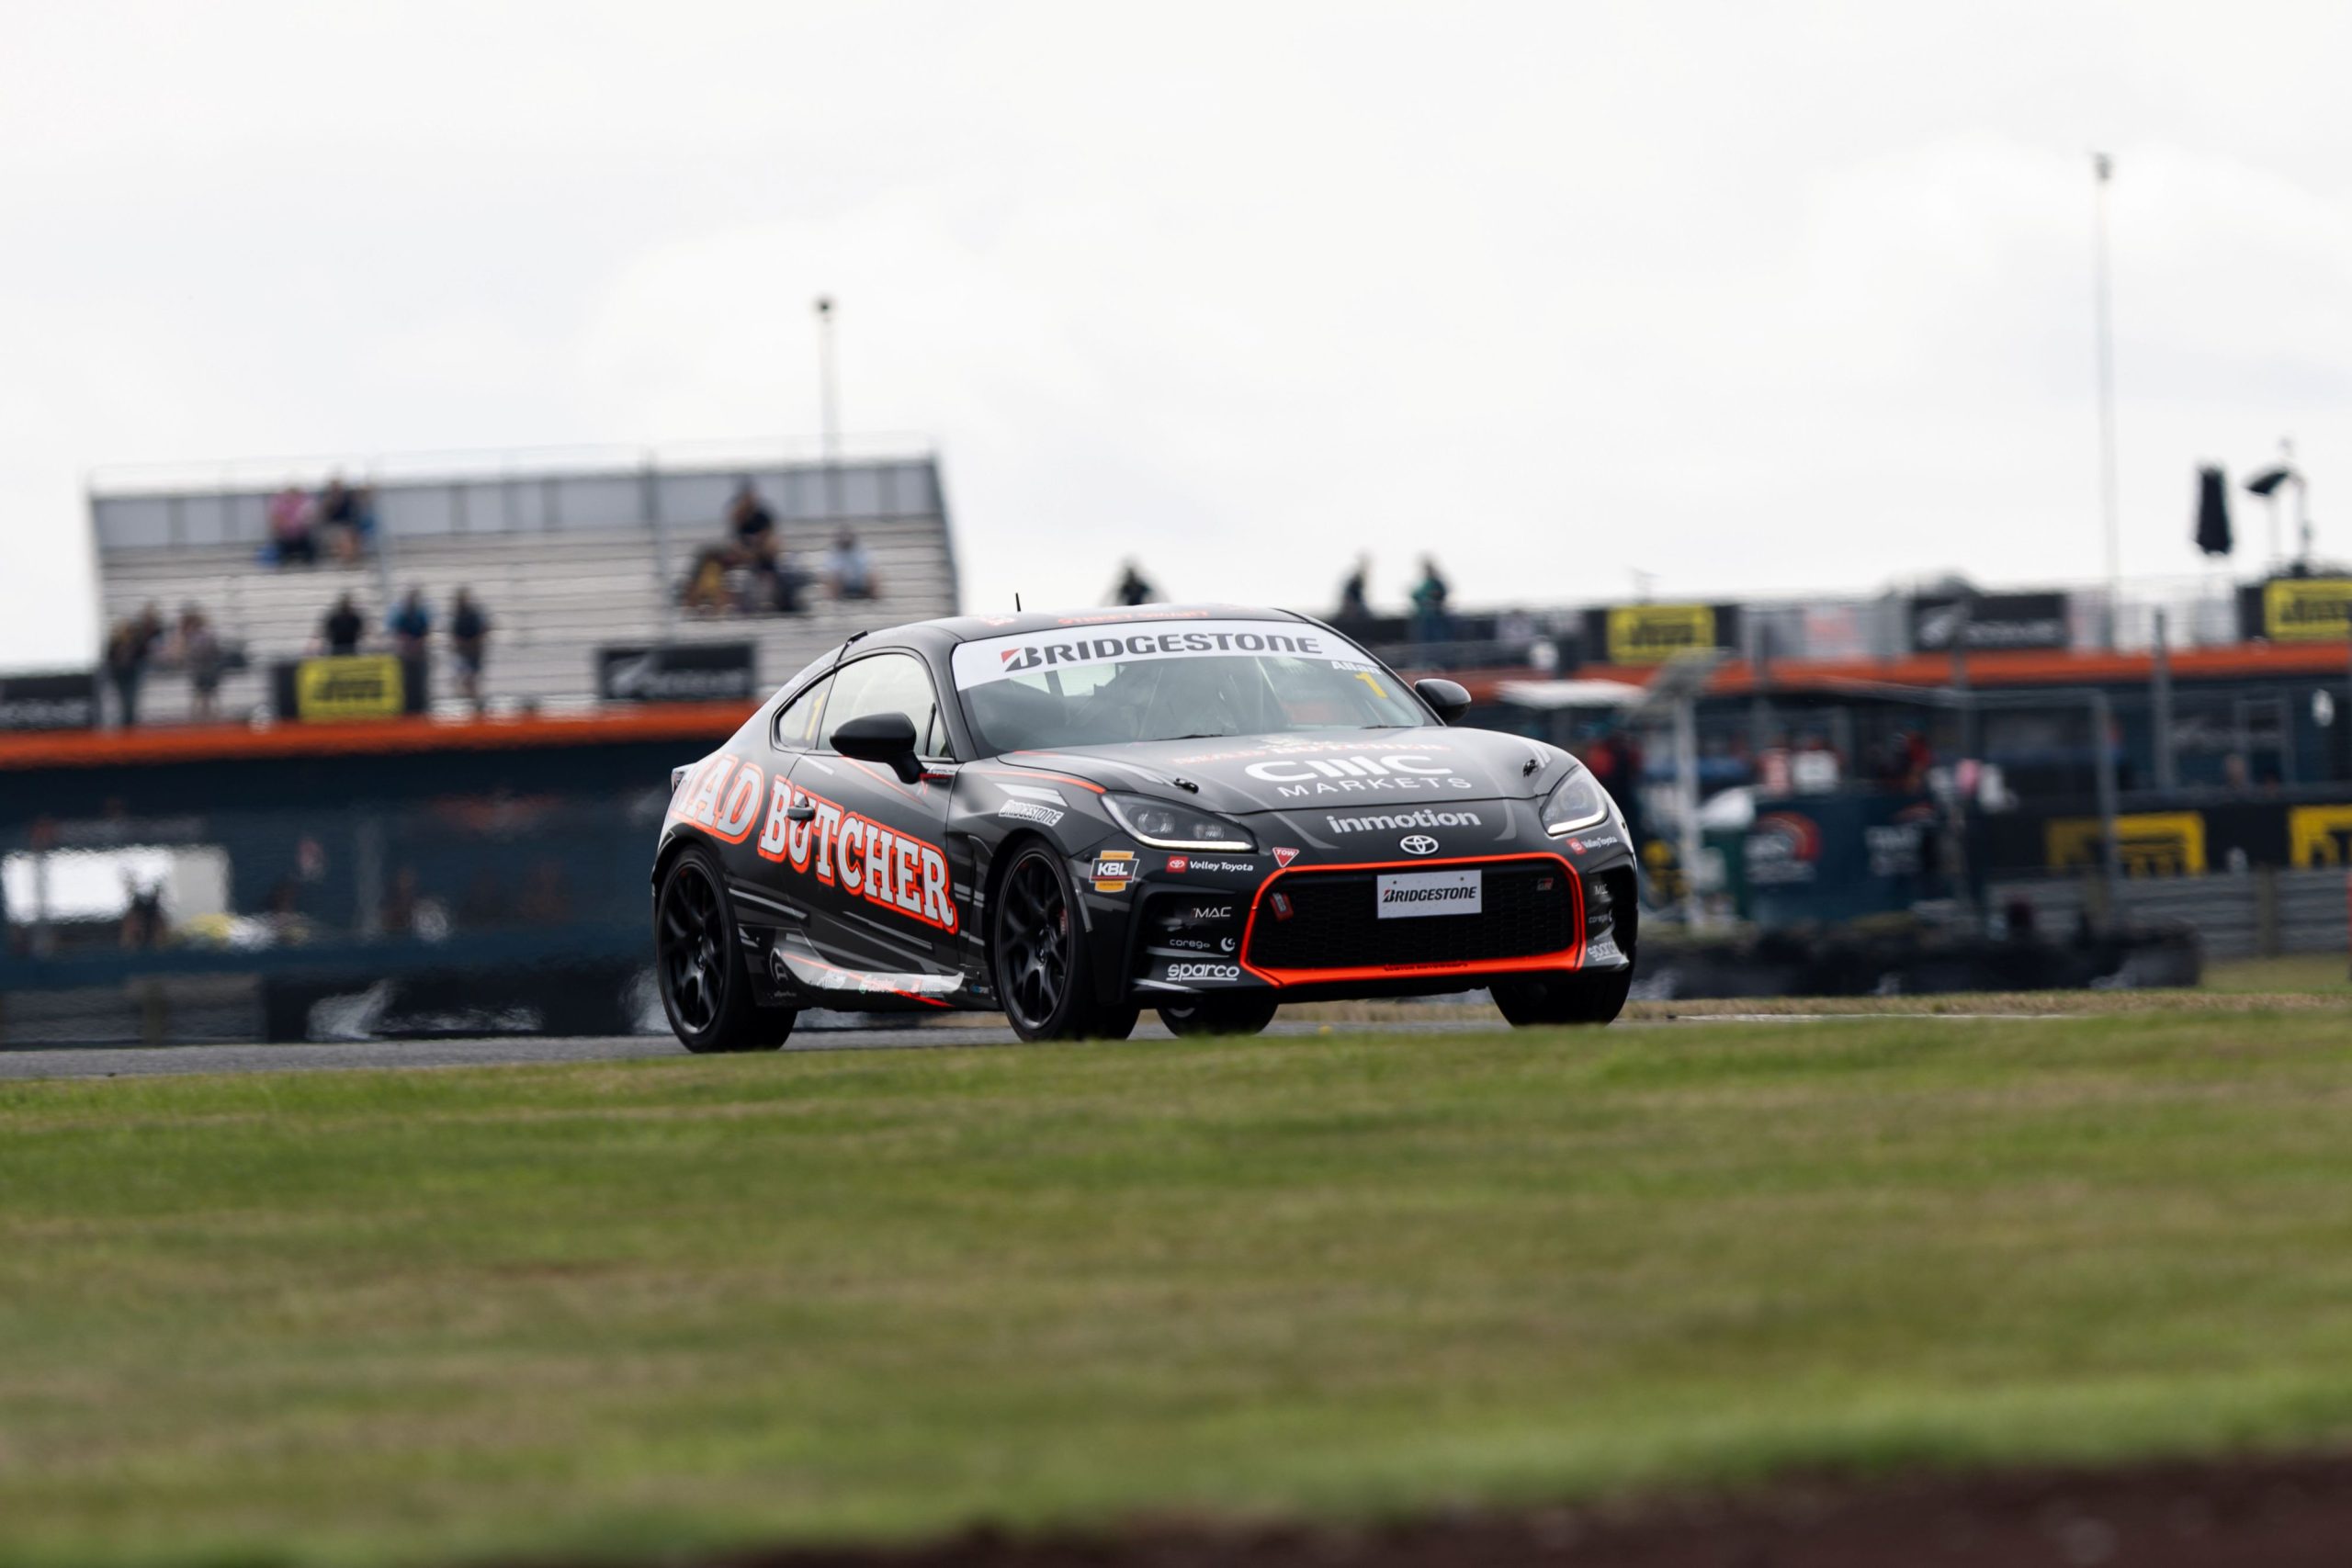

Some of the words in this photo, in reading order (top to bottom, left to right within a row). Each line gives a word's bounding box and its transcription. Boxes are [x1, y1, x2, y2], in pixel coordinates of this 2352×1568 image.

[1001, 633, 1323, 671] BRIDGESTONE
[1354, 671, 1388, 699] 1
[1277, 777, 1473, 797] MARKETS
[1326, 809, 1482, 834] inmotion
[758, 775, 957, 932] BUTCHER
[1275, 849, 1296, 857] TOW
[1097, 862, 1128, 876] KBL
[1190, 861, 1220, 872] Valley
[1220, 862, 1254, 873] Toyota
[1383, 886, 1477, 903] BRIDGESTONE
[1167, 963, 1239, 982] sparco
